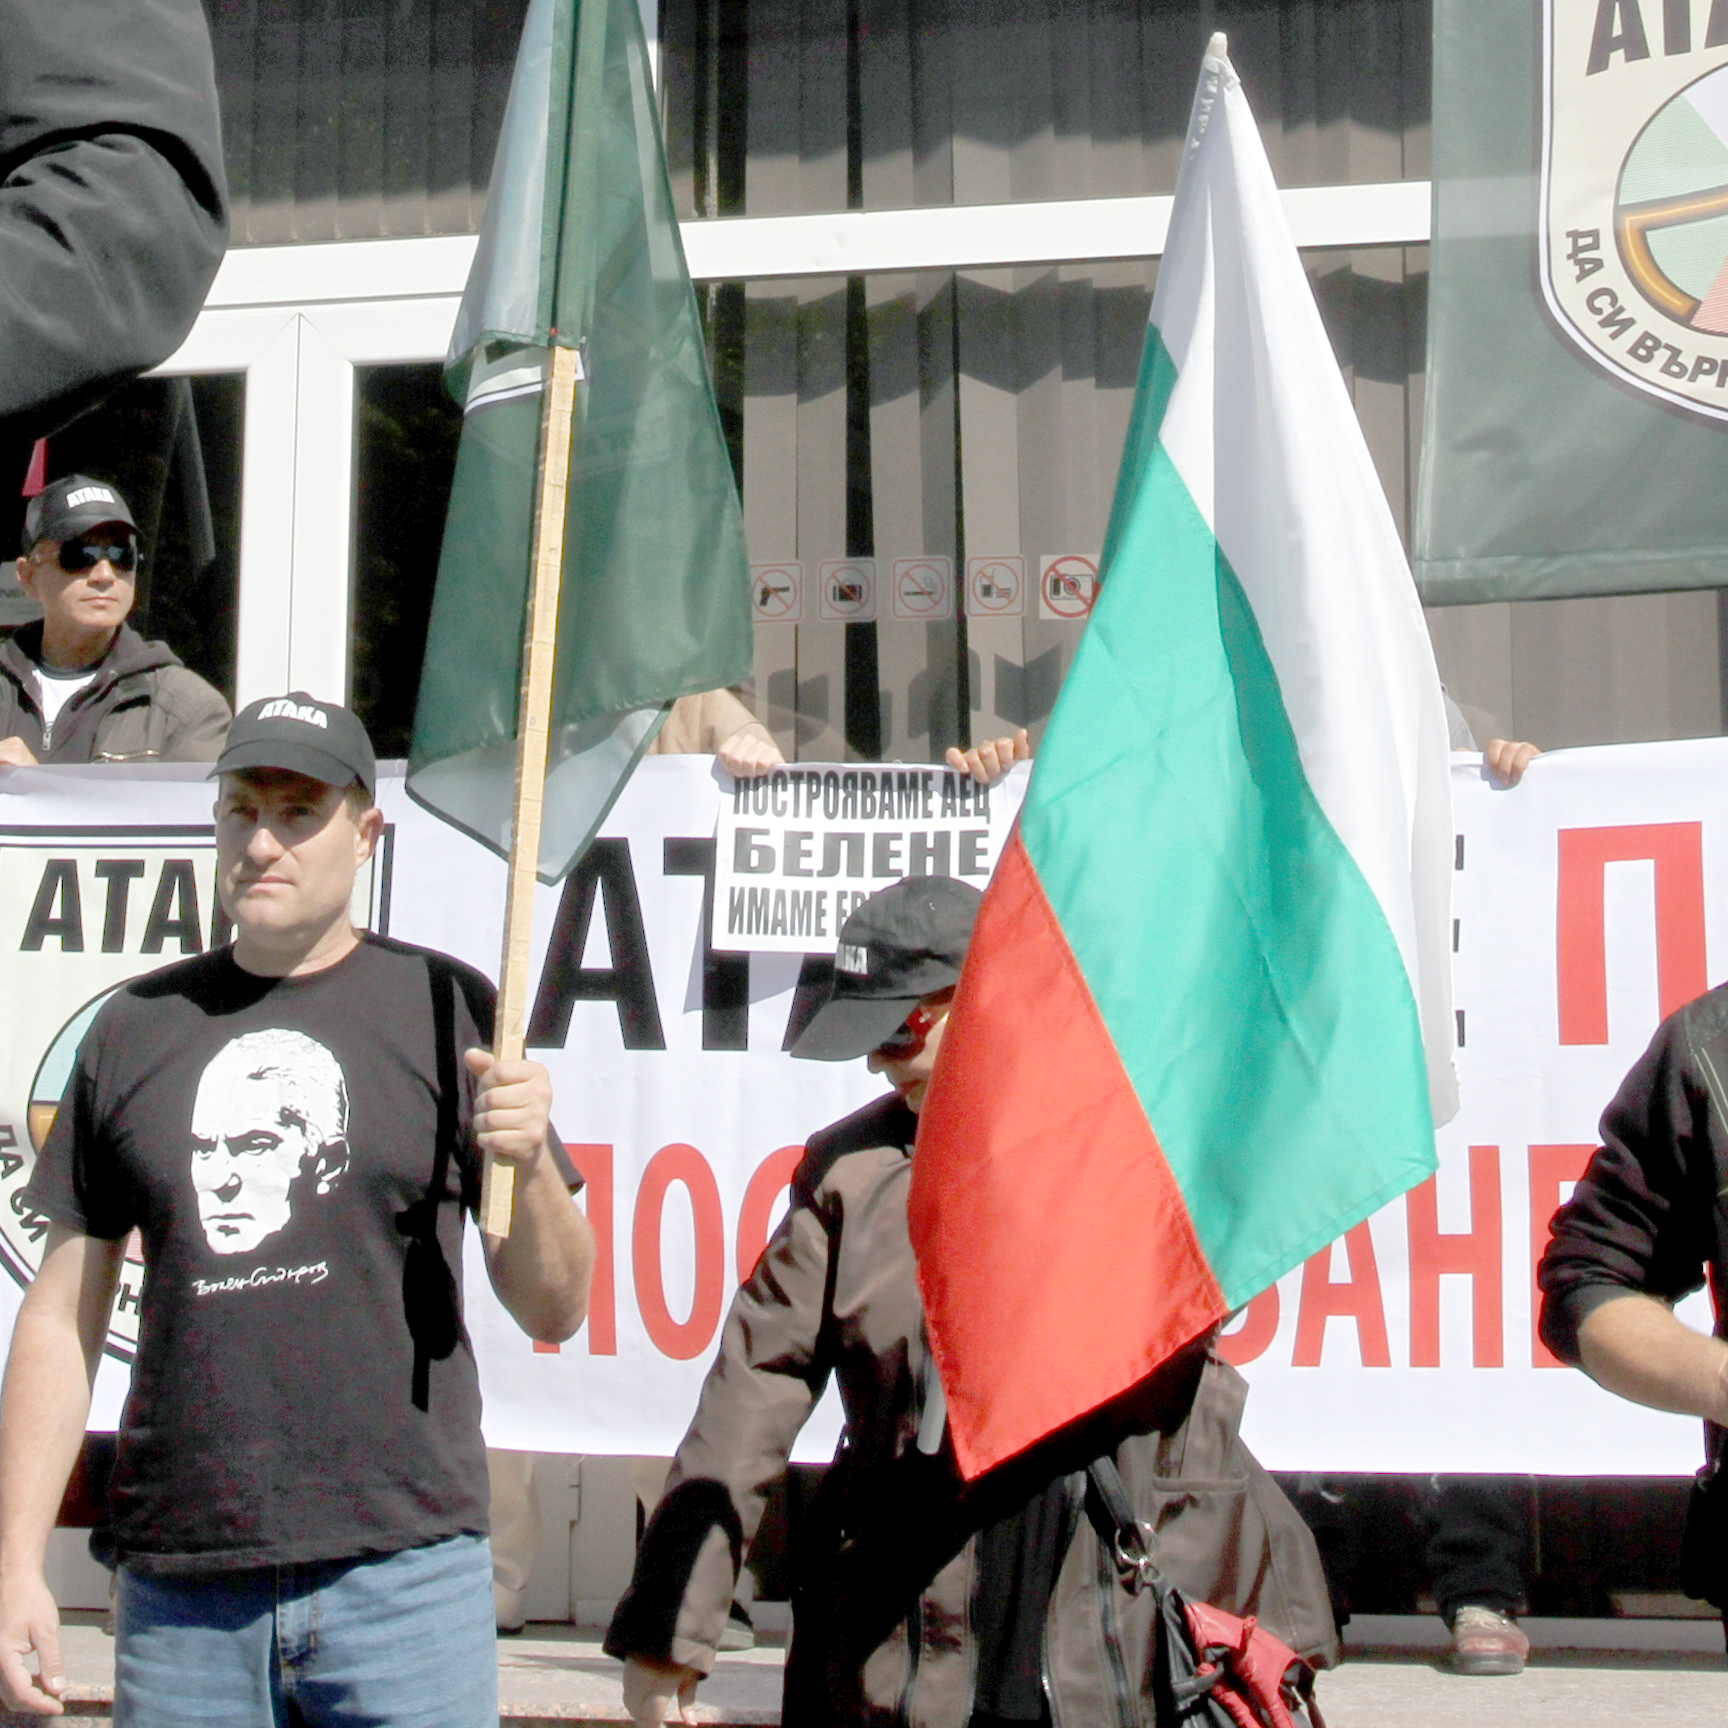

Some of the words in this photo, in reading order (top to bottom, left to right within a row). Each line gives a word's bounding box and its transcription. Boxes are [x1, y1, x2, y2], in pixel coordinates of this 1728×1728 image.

[1565, 228, 1605, 284] ДА
[1585, 285, 1637, 341] СИ
[66, 486, 116, 509] АТАКА
[257, 699, 328, 729] АТАКА
[732, 827, 991, 878] БЕЛЕНЕ
[727, 886, 828, 938] ИМАМЕ
